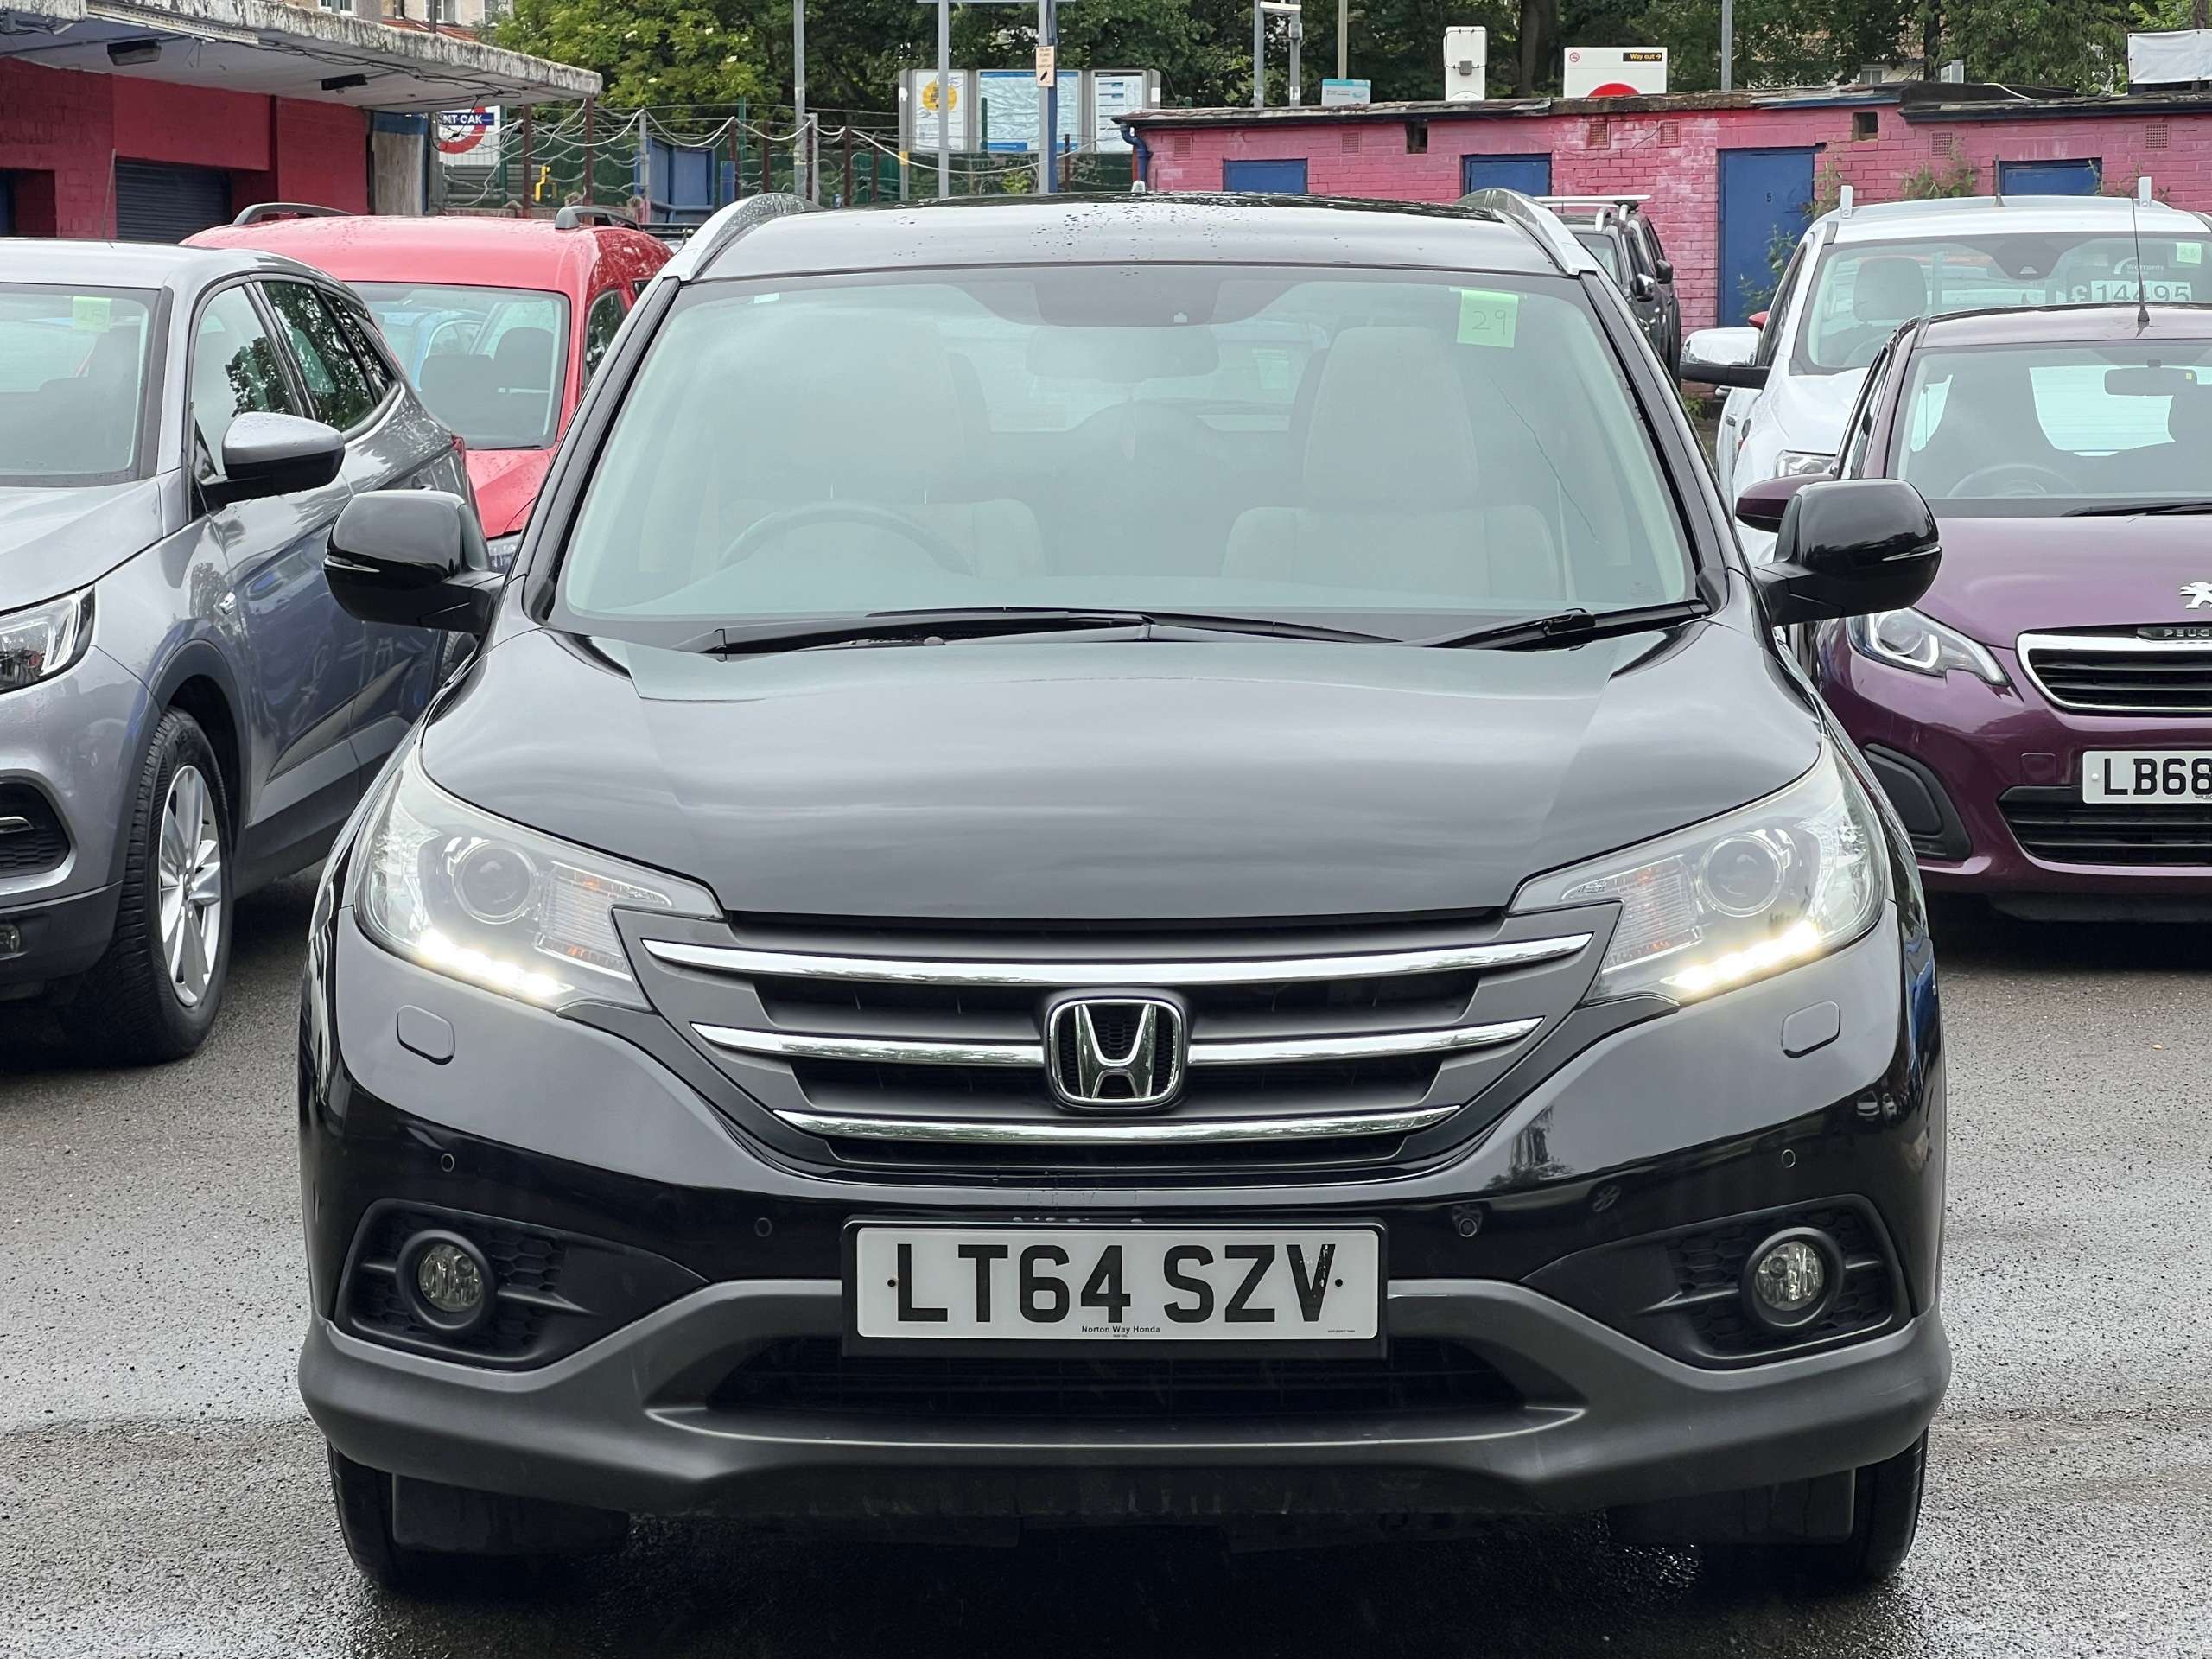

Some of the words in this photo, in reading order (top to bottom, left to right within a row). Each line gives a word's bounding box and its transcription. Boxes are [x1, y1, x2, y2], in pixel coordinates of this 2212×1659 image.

[460, 114, 482, 124] OAK
[1766, 192, 1772, 202] 5
[1471, 309, 1507, 337] 29
[2104, 758, 2212, 795] LB68
[897, 1243, 1131, 1323] LT64
[1163, 1243, 1337, 1323] SZV
[1112, 1325, 1130, 1334] Way
